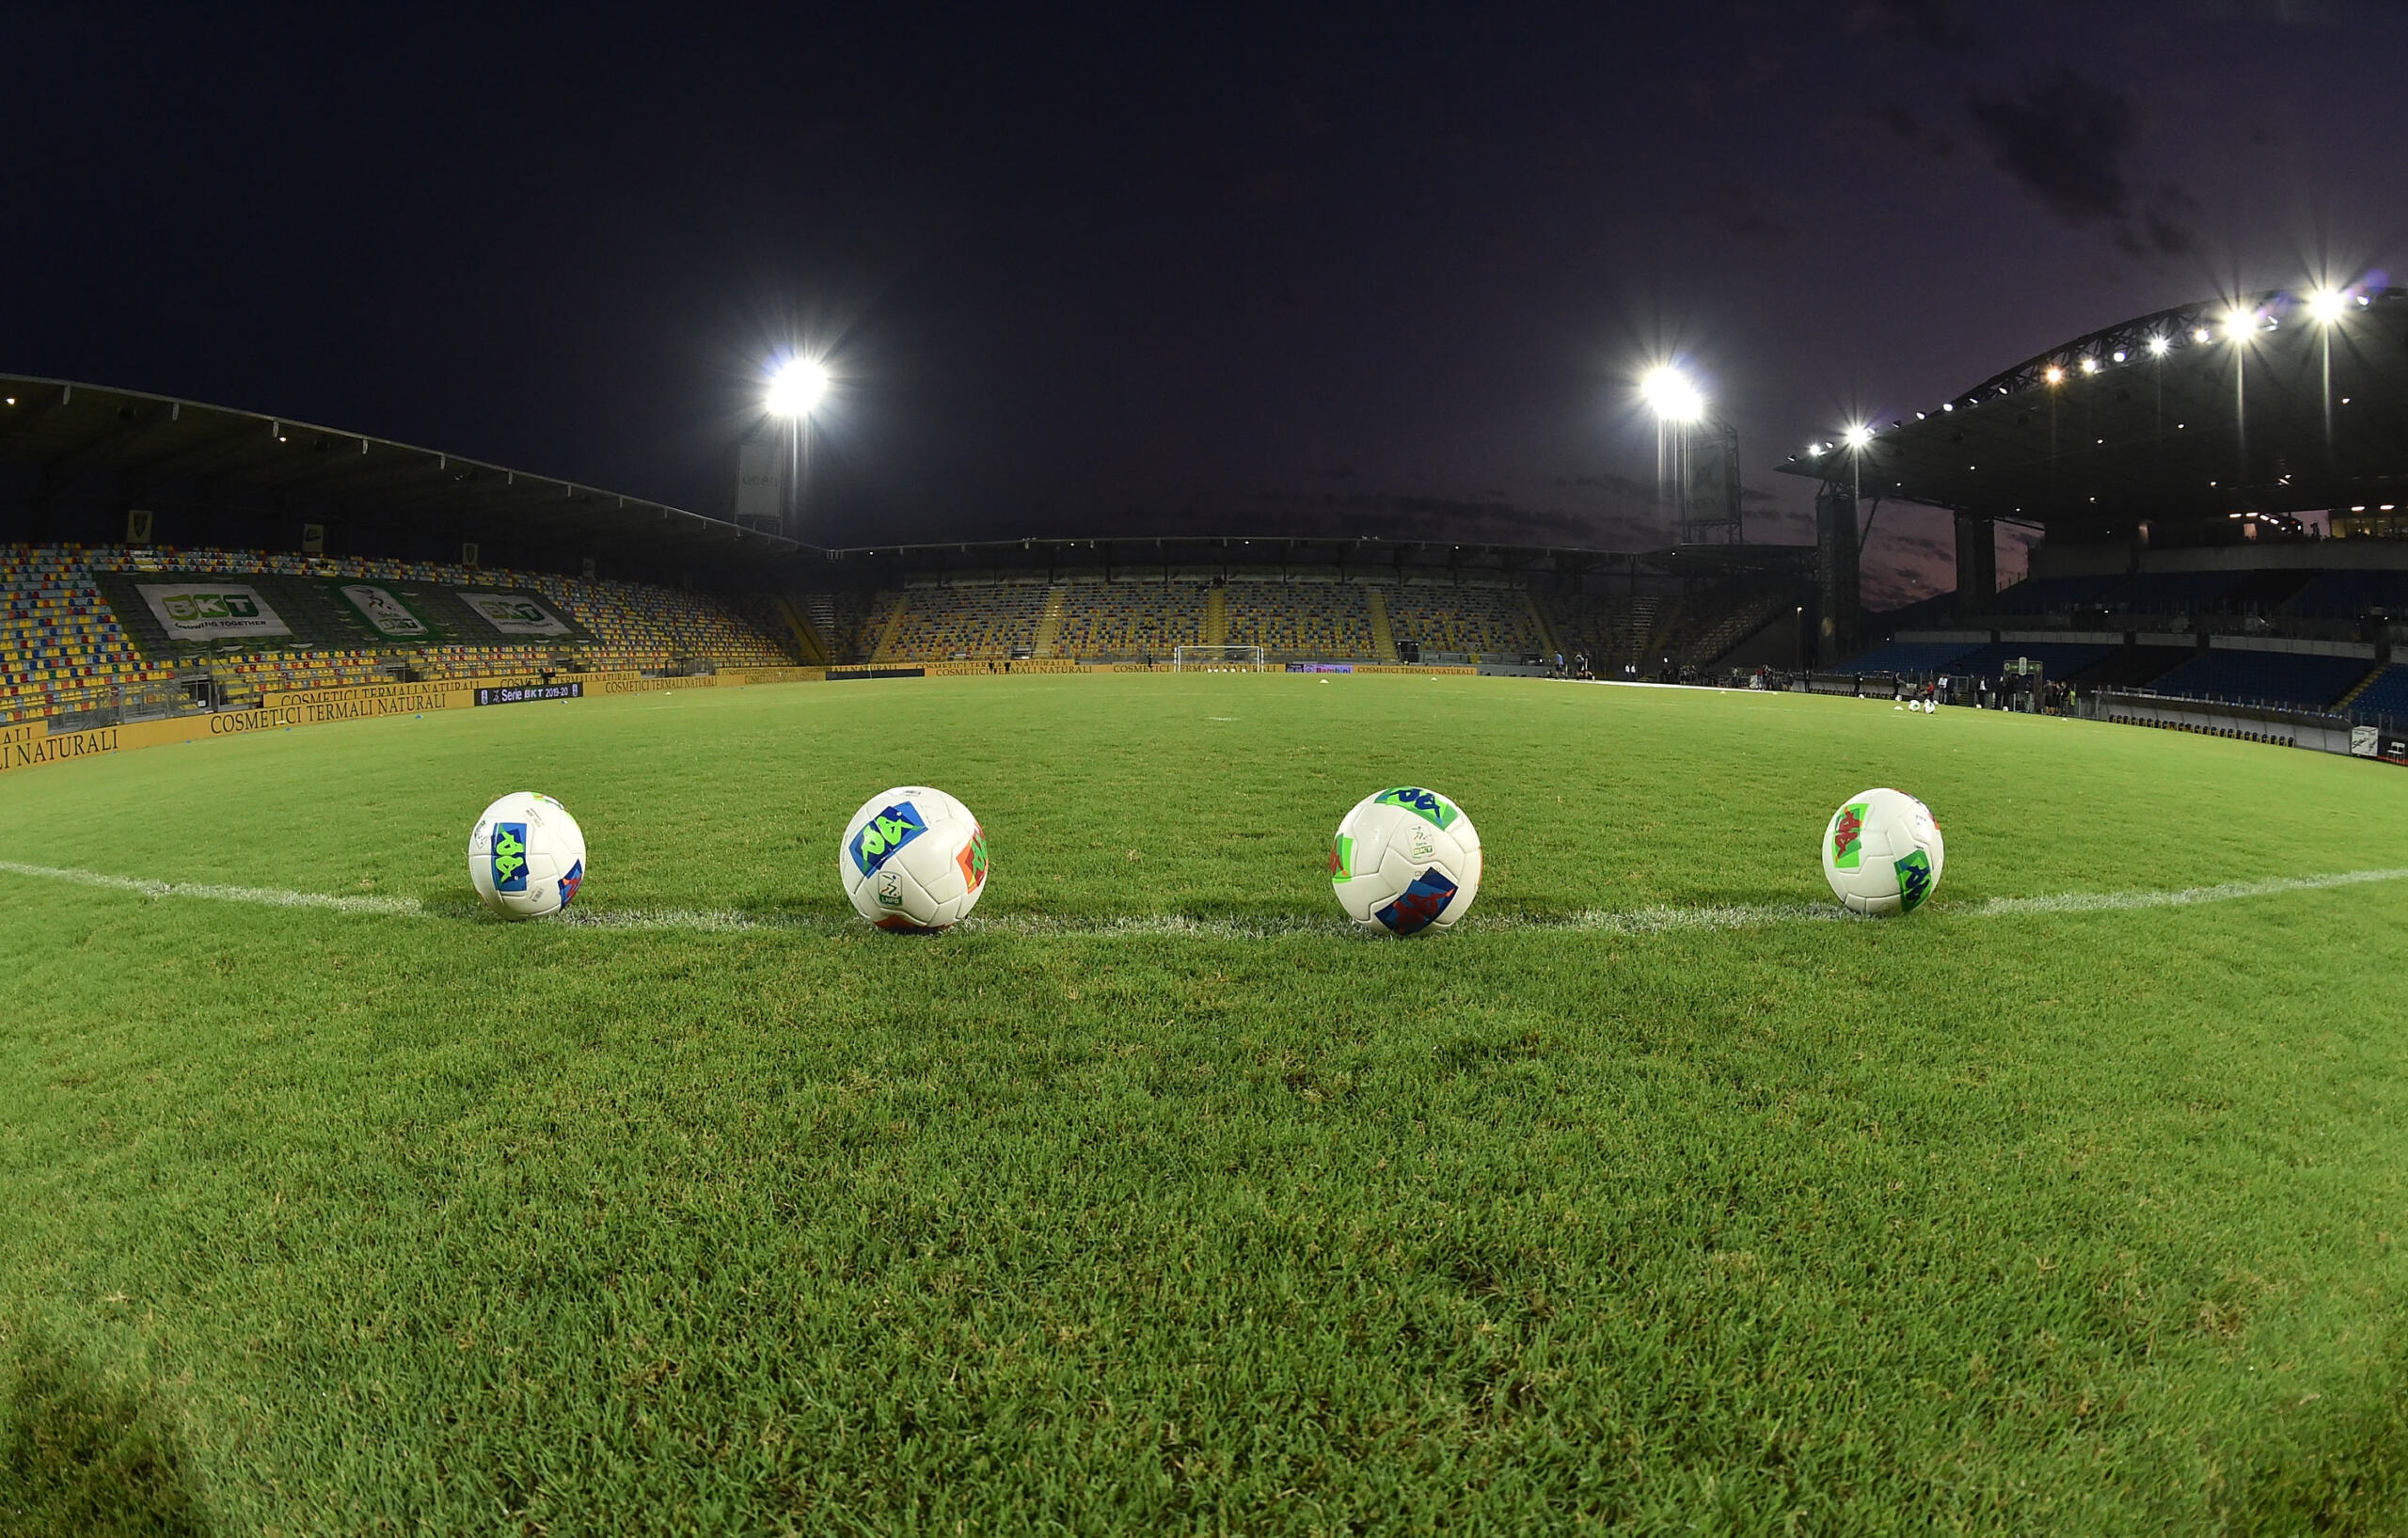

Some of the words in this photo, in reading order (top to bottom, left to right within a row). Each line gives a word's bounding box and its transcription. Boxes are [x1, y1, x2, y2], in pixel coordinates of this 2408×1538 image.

[164, 595, 256, 620] BKT
[1040, 666, 1092, 674] NATURALI
[501, 688, 523, 702] Serie
[524, 689, 544, 699] BKT
[545, 686, 569, 698] 2019-20
[606, 679, 650, 693] COSMETICI
[652, 678, 683, 690] TERMALI
[211, 706, 302, 734] COSMETICI
[307, 698, 373, 722] TERMALI
[378, 692, 447, 715] NATURALI
[16, 729, 119, 767] NATURALI
